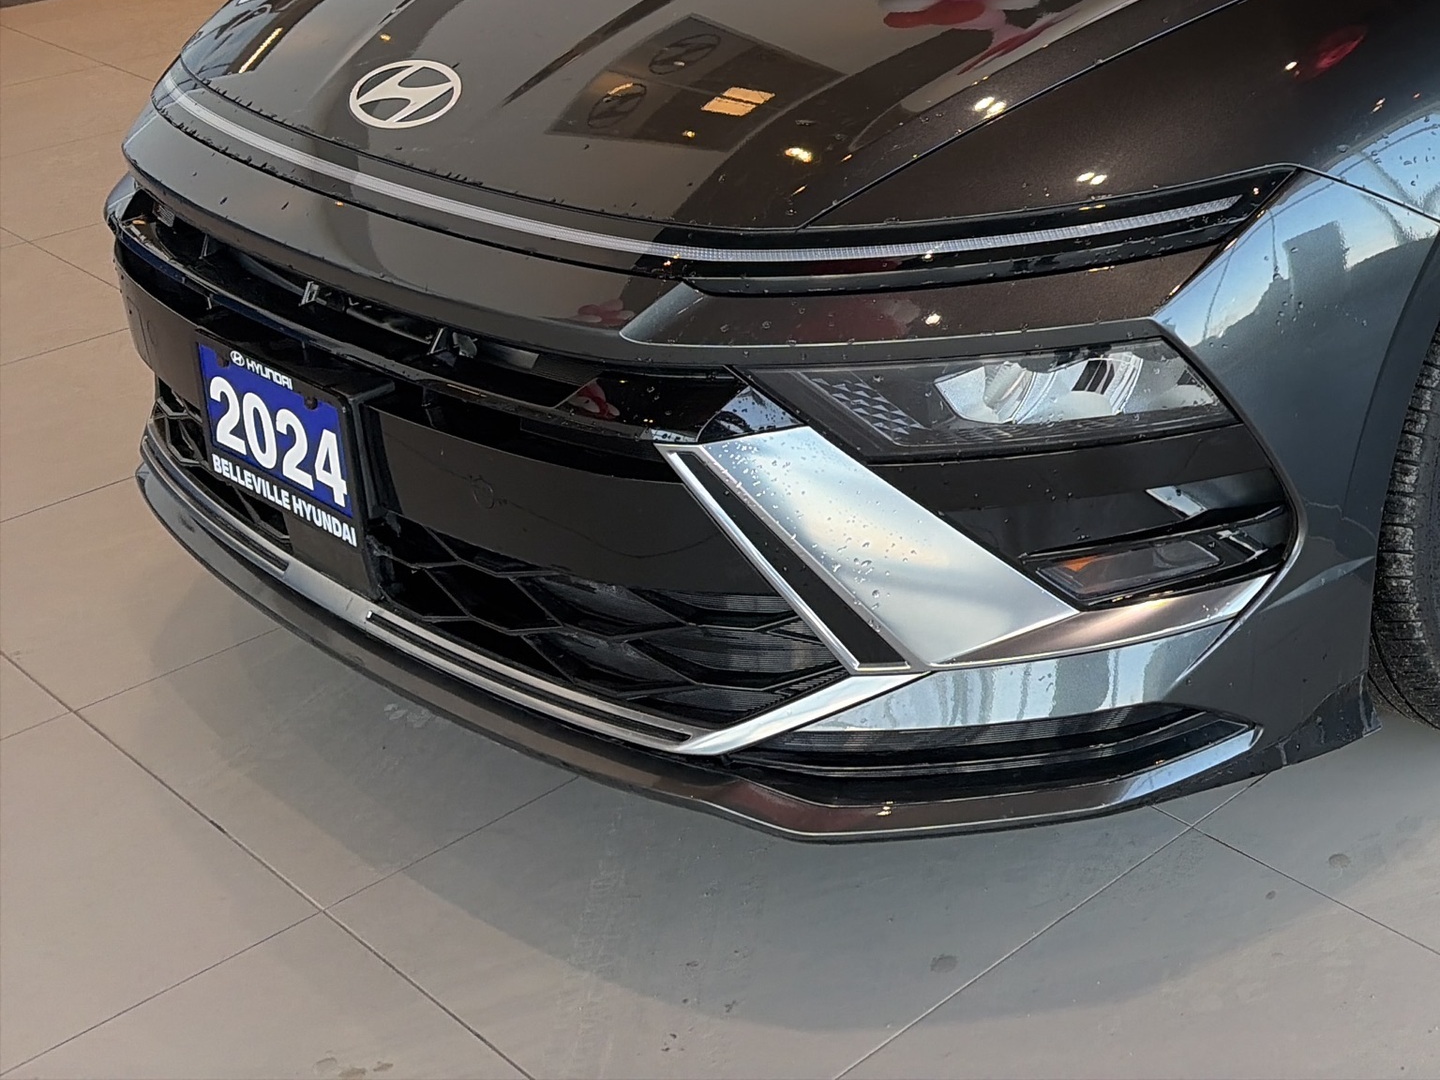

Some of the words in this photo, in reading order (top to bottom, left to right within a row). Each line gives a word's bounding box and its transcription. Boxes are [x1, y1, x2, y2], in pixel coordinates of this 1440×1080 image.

[246, 358, 293, 390] HYUNDAI
[210, 376, 347, 507] 2024
[212, 453, 291, 510] BELLEVILLE
[291, 493, 357, 547] HYUNDAI
